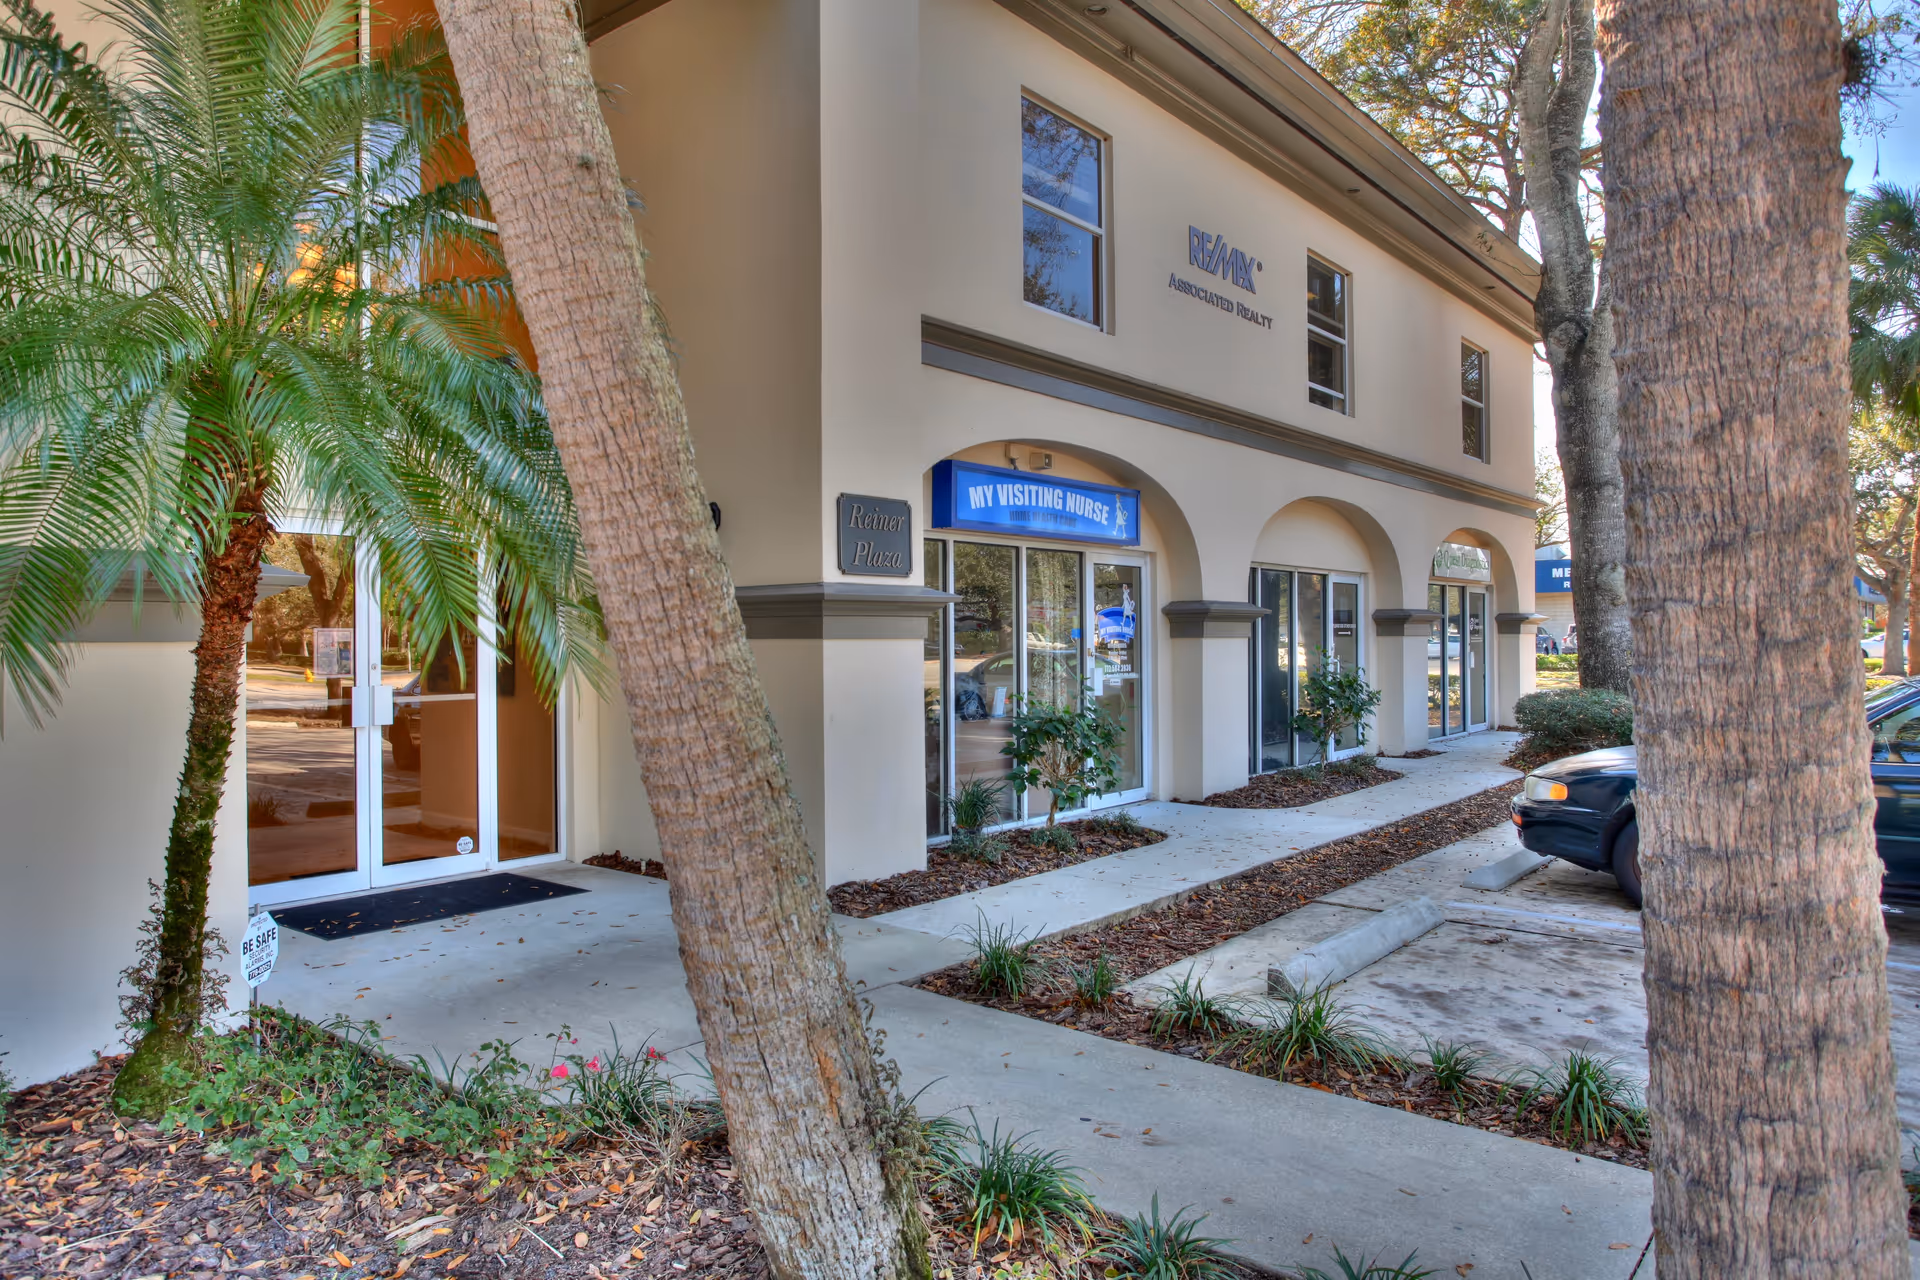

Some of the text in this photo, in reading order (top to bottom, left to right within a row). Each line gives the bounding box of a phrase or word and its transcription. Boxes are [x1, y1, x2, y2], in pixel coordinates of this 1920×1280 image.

[1188, 224, 1256, 295] RE/MAX
[1168, 272, 1273, 329] ASSOCIATED REALTY
[847, 503, 905, 532] Reiner
[968, 483, 1110, 525] MY VISITING NURSE
[851, 541, 903, 569] Plaza
[242, 927, 276, 955] BE SAFE
[249, 944, 271, 960] SECURITY
